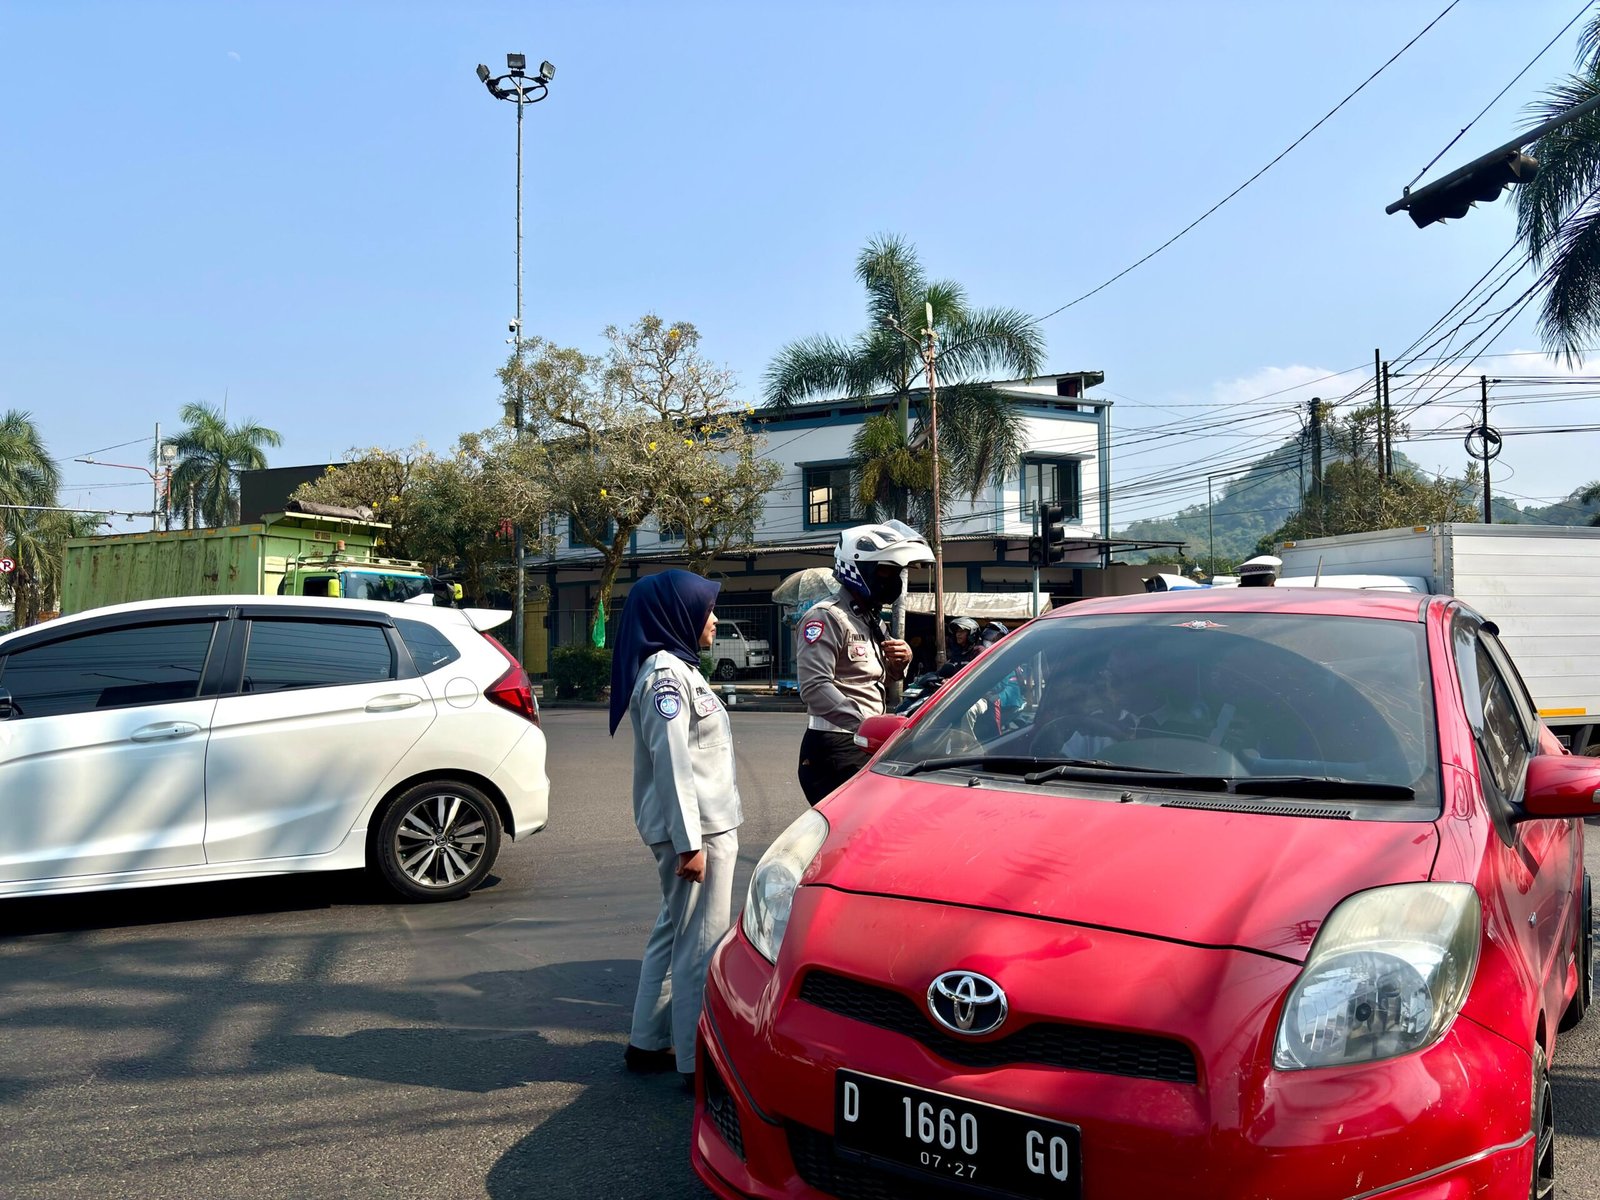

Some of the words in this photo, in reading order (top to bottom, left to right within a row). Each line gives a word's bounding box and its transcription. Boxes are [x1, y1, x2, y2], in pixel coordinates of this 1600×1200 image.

[843, 1080, 860, 1123] D
[902, 1096, 978, 1155] 1660
[1026, 1130, 1068, 1181] GQ
